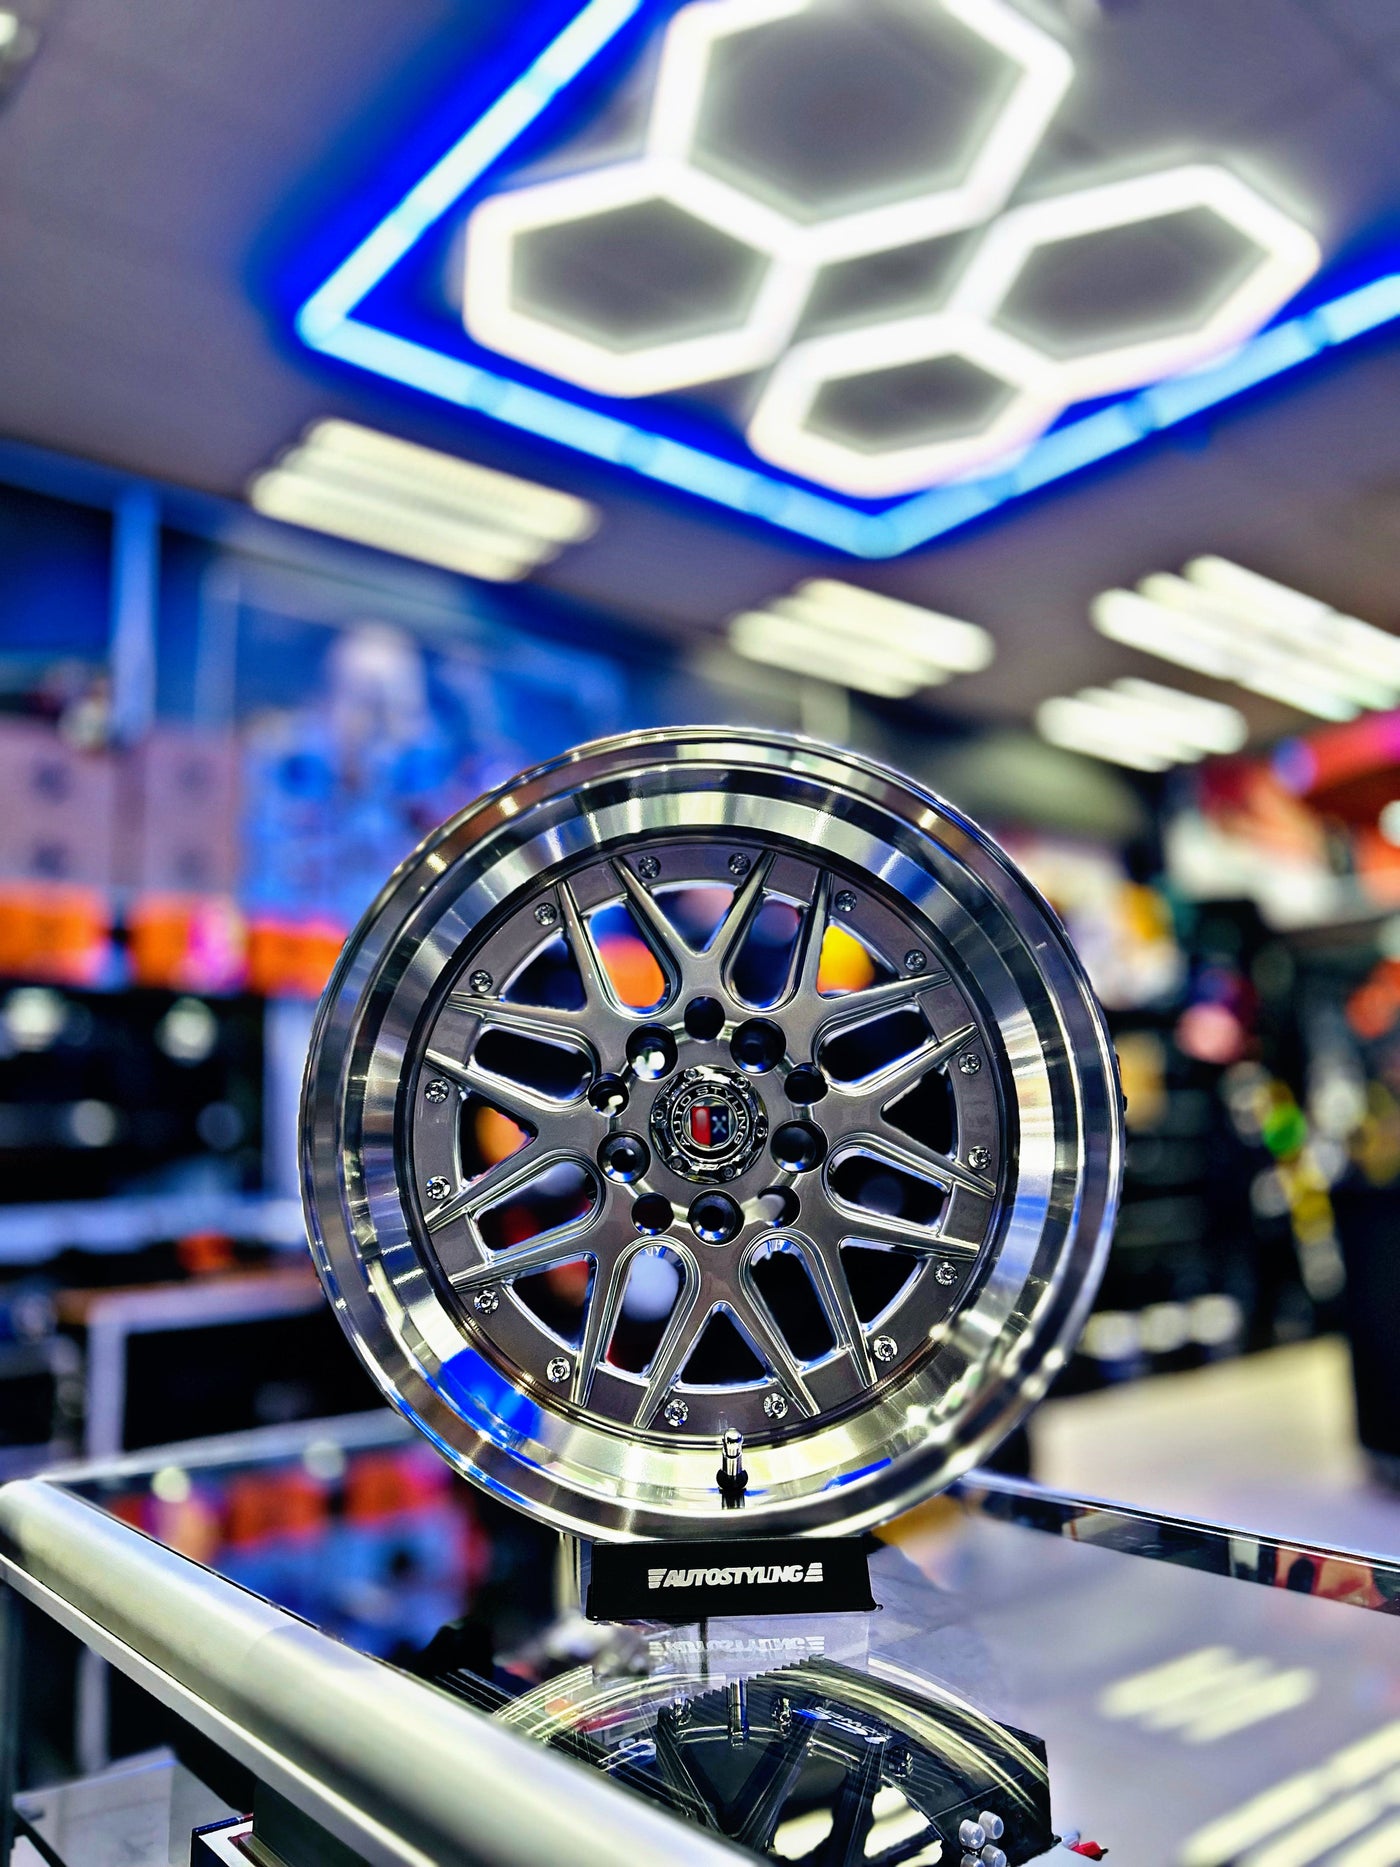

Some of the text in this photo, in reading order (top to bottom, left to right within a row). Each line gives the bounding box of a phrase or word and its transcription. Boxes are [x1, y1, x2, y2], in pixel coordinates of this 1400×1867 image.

[673, 1086, 747, 1146] AUTO STYLING
[662, 1564, 804, 1588] AUTOSTYLING
